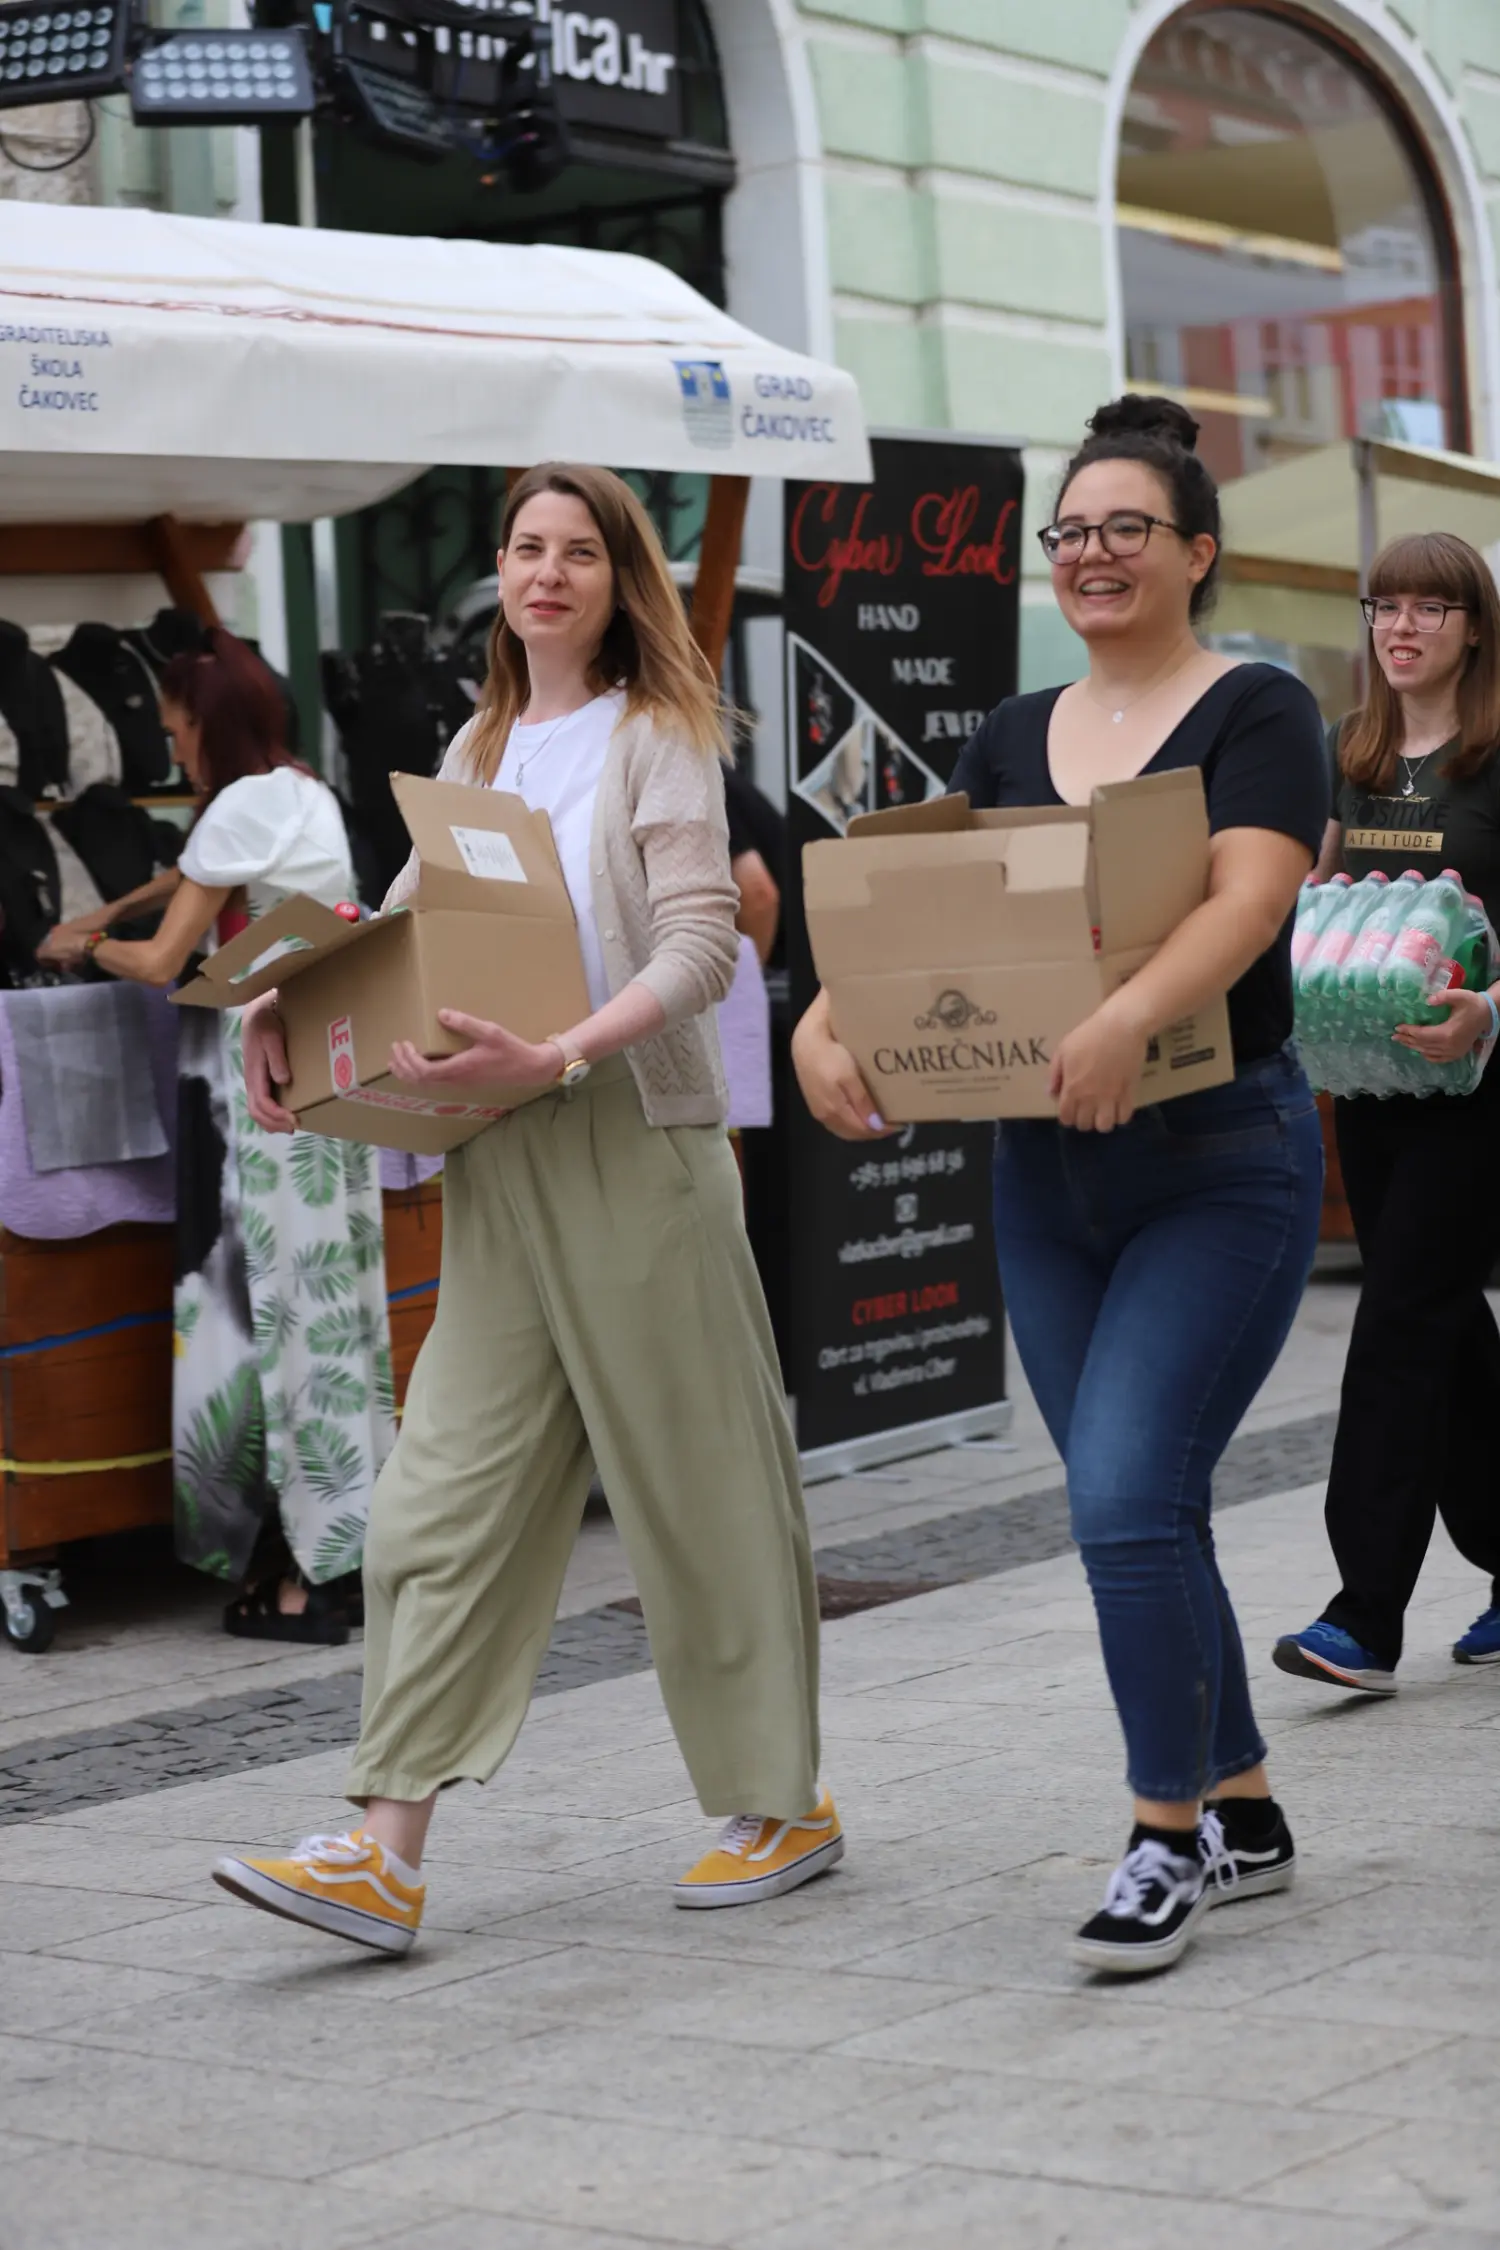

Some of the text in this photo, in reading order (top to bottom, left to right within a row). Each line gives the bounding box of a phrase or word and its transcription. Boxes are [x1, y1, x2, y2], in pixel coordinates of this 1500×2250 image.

[31, 353, 84, 379] ŠKOLA
[19, 384, 99, 411] ČAKOVEC
[754, 373, 813, 401] GRAD
[741, 405, 835, 443] ČAKOVEC
[790, 482, 1017, 608] Cyber Look
[857, 604, 920, 631] HAND
[892, 657, 955, 686] MADE
[1346, 801, 1450, 829] POSITIVE
[1347, 832, 1433, 848] ATTITUDE
